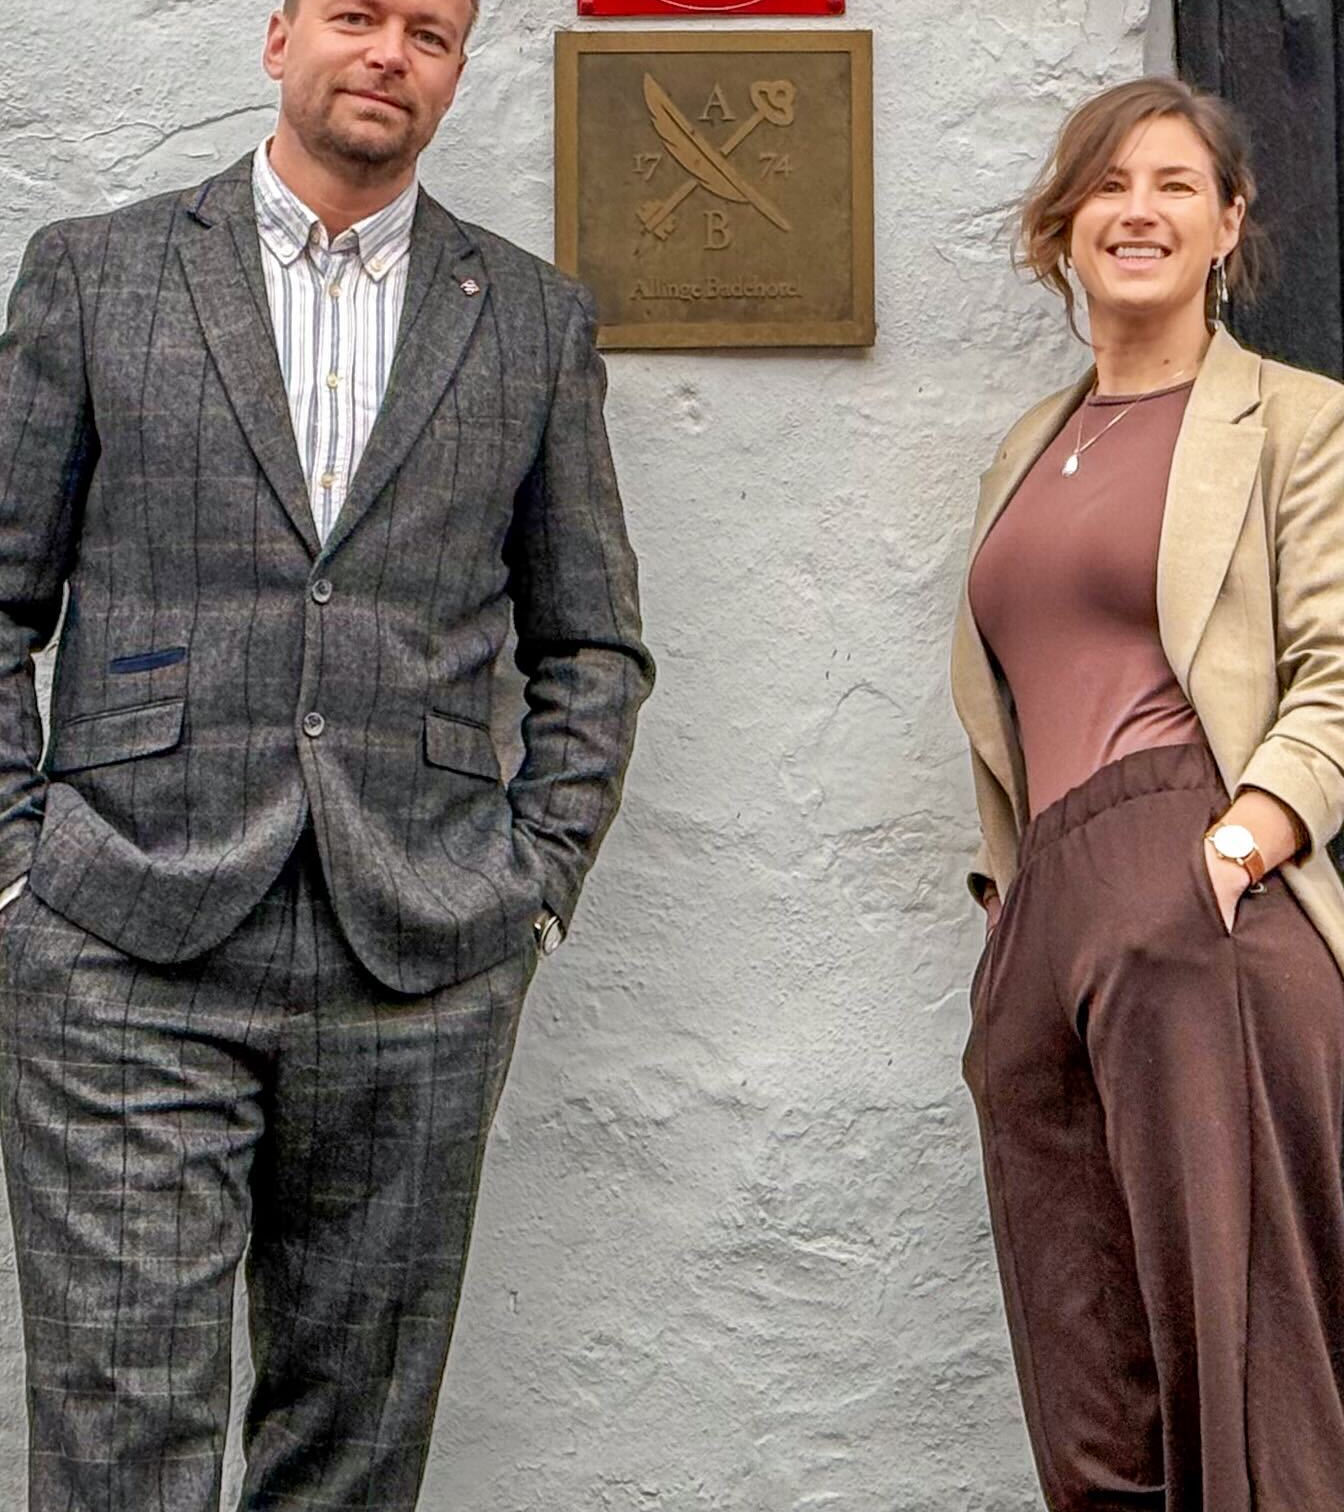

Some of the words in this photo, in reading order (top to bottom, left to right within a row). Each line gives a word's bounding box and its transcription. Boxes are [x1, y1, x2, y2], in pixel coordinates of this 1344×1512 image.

[698, 82, 736, 123] A
[632, 152, 661, 181] 17
[759, 152, 793, 181] 74
[703, 211, 733, 251] B
[630, 276, 702, 301] Allinge
[704, 275, 803, 299] Badehotel
